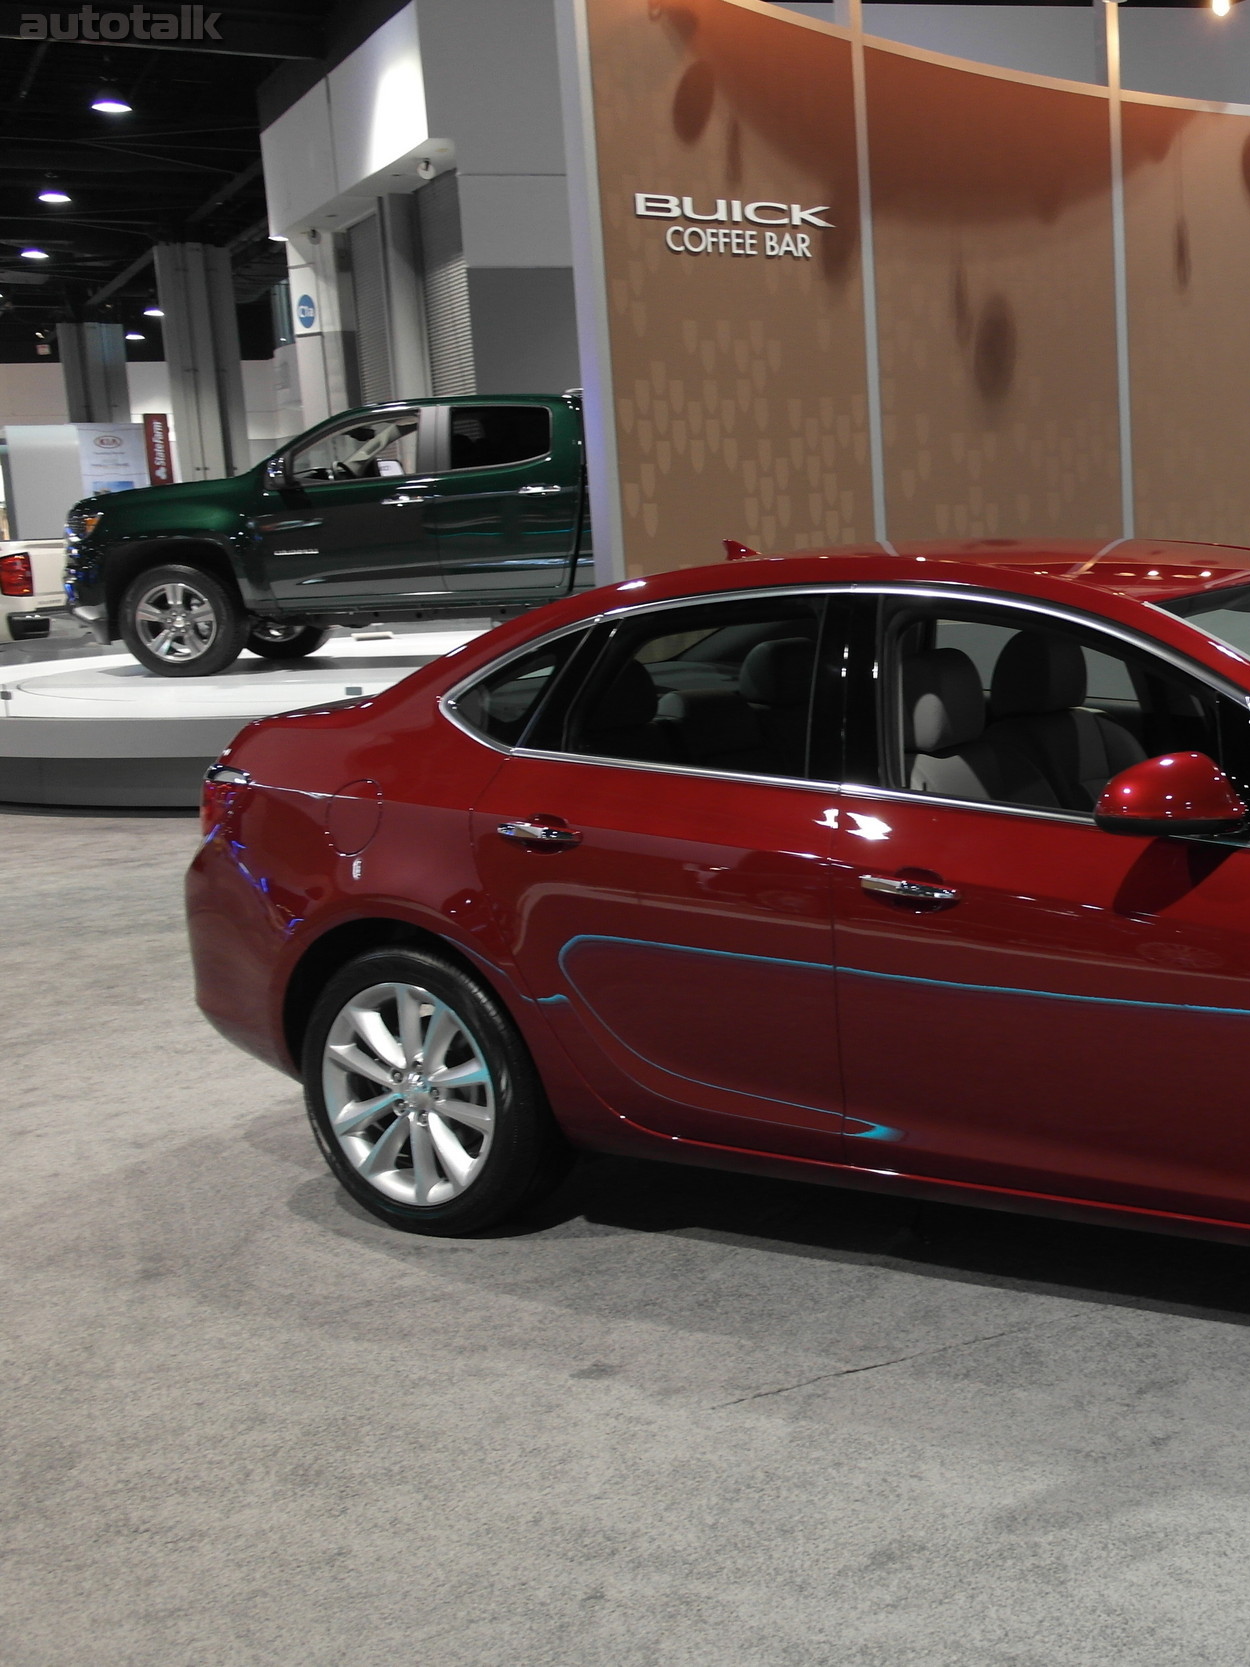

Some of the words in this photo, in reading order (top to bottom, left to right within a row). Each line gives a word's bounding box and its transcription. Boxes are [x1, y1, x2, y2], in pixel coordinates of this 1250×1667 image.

[635, 193, 836, 228] BUICK
[666, 226, 758, 255] COFFEE
[765, 232, 812, 257] BAR
[152, 421, 164, 443] Farm
[153, 443, 166, 467] State
